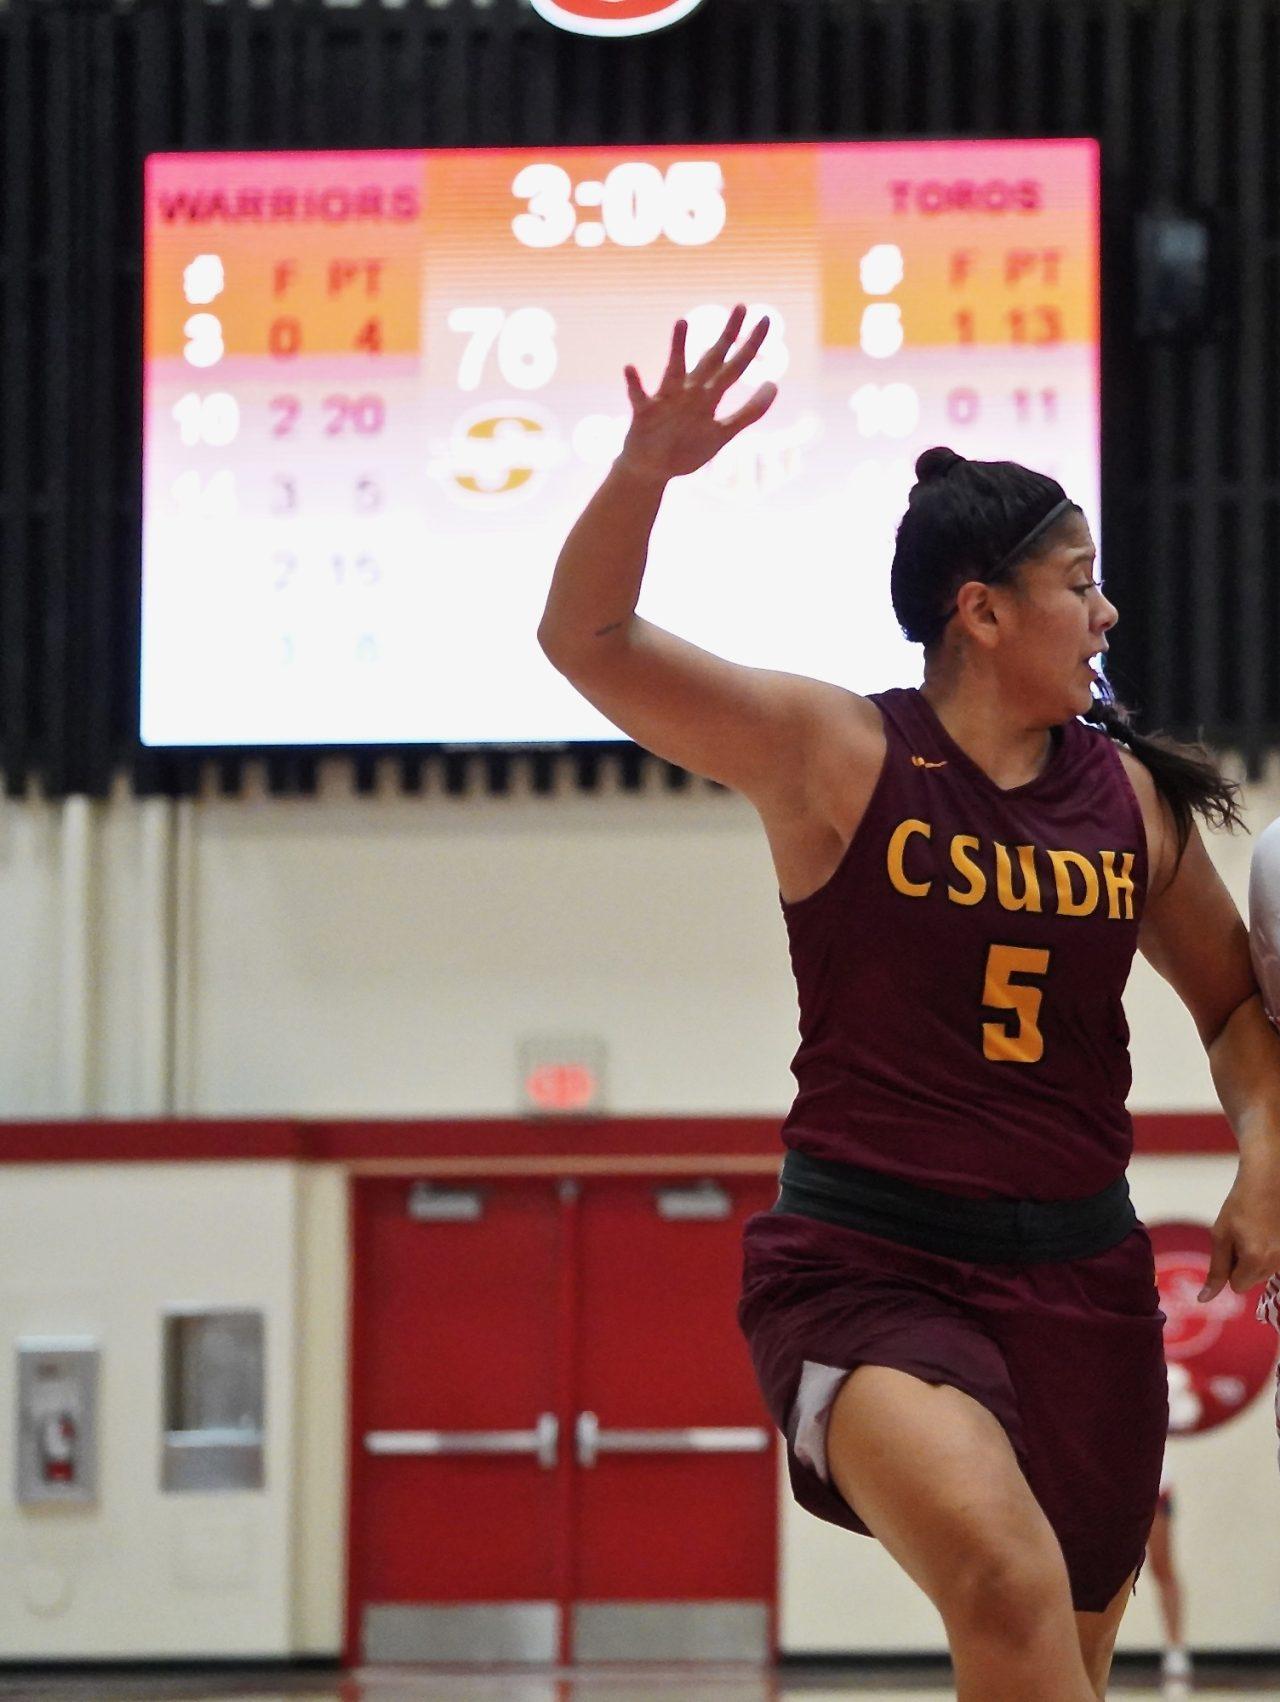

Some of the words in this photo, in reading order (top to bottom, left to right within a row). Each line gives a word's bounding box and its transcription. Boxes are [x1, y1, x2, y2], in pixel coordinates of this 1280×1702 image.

[159, 184, 420, 224] WARRIORS
[511, 161, 727, 248] 3:05
[888, 179, 1042, 217] TOROS
[353, 315, 382, 356] 4
[447, 307, 558, 391] 76
[268, 394, 300, 437] 2
[322, 394, 386, 437] 20
[886, 818, 1136, 920] CSUDH
[981, 943, 1051, 1063] 5
